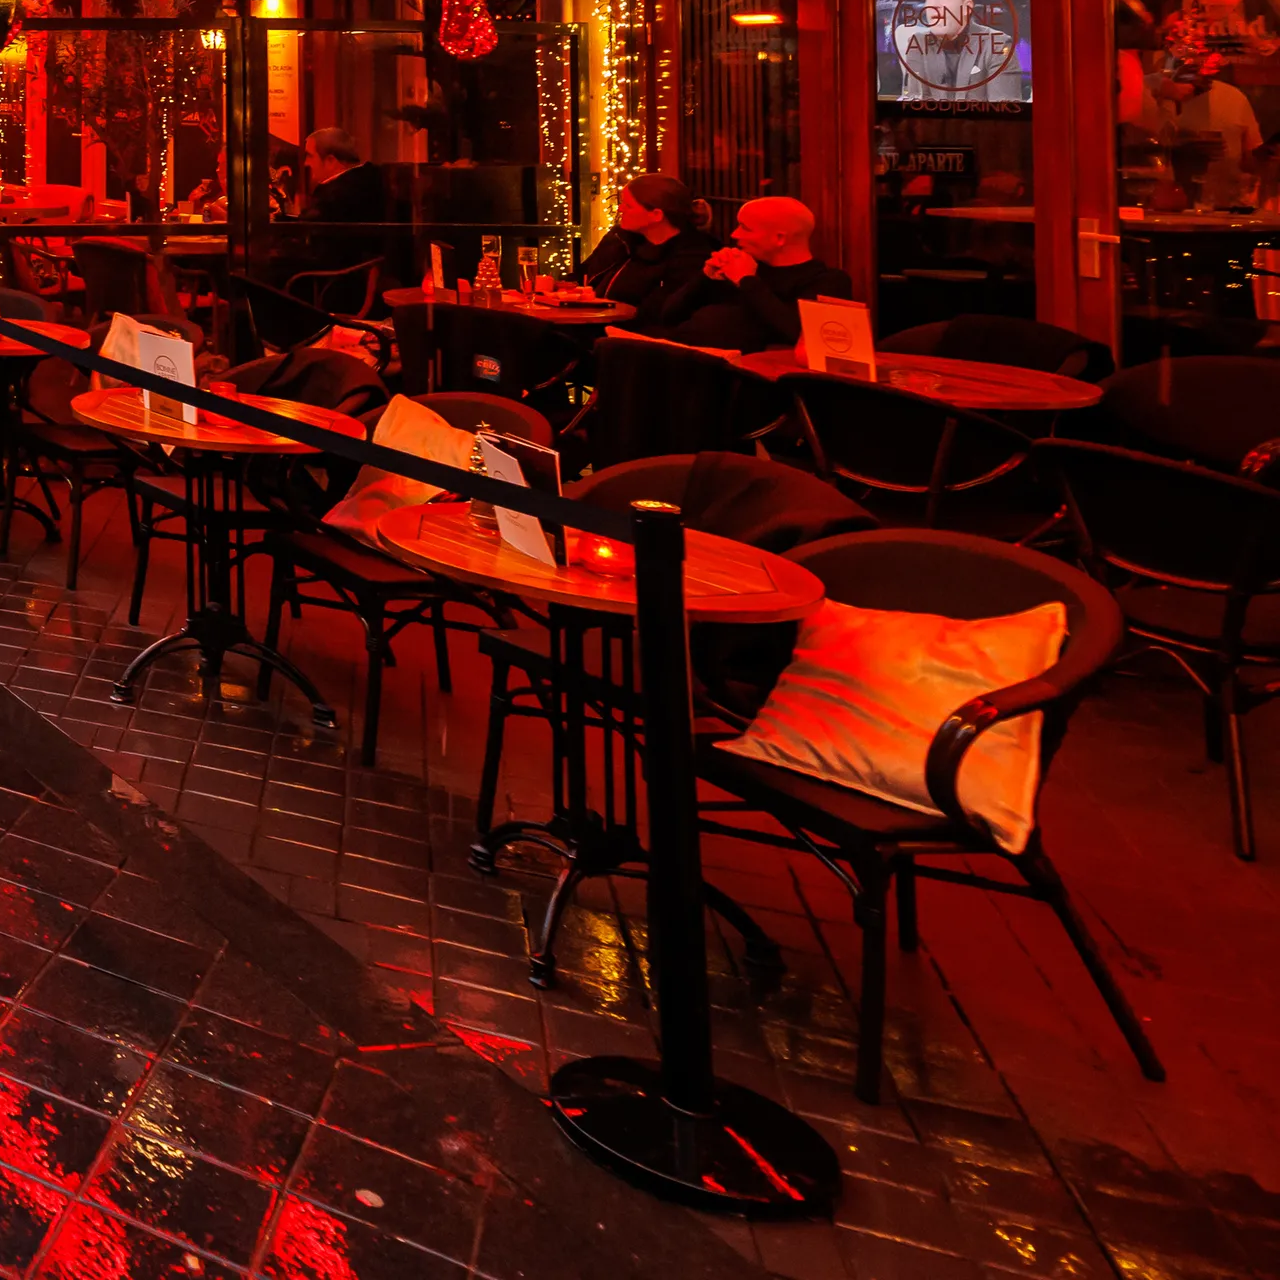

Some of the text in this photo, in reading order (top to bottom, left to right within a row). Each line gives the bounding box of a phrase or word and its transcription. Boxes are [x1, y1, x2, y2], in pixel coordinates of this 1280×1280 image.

[903, 3, 1004, 28] BONNE
[905, 32, 1006, 55] APARTE
[907, 152, 965, 172] APARTE
